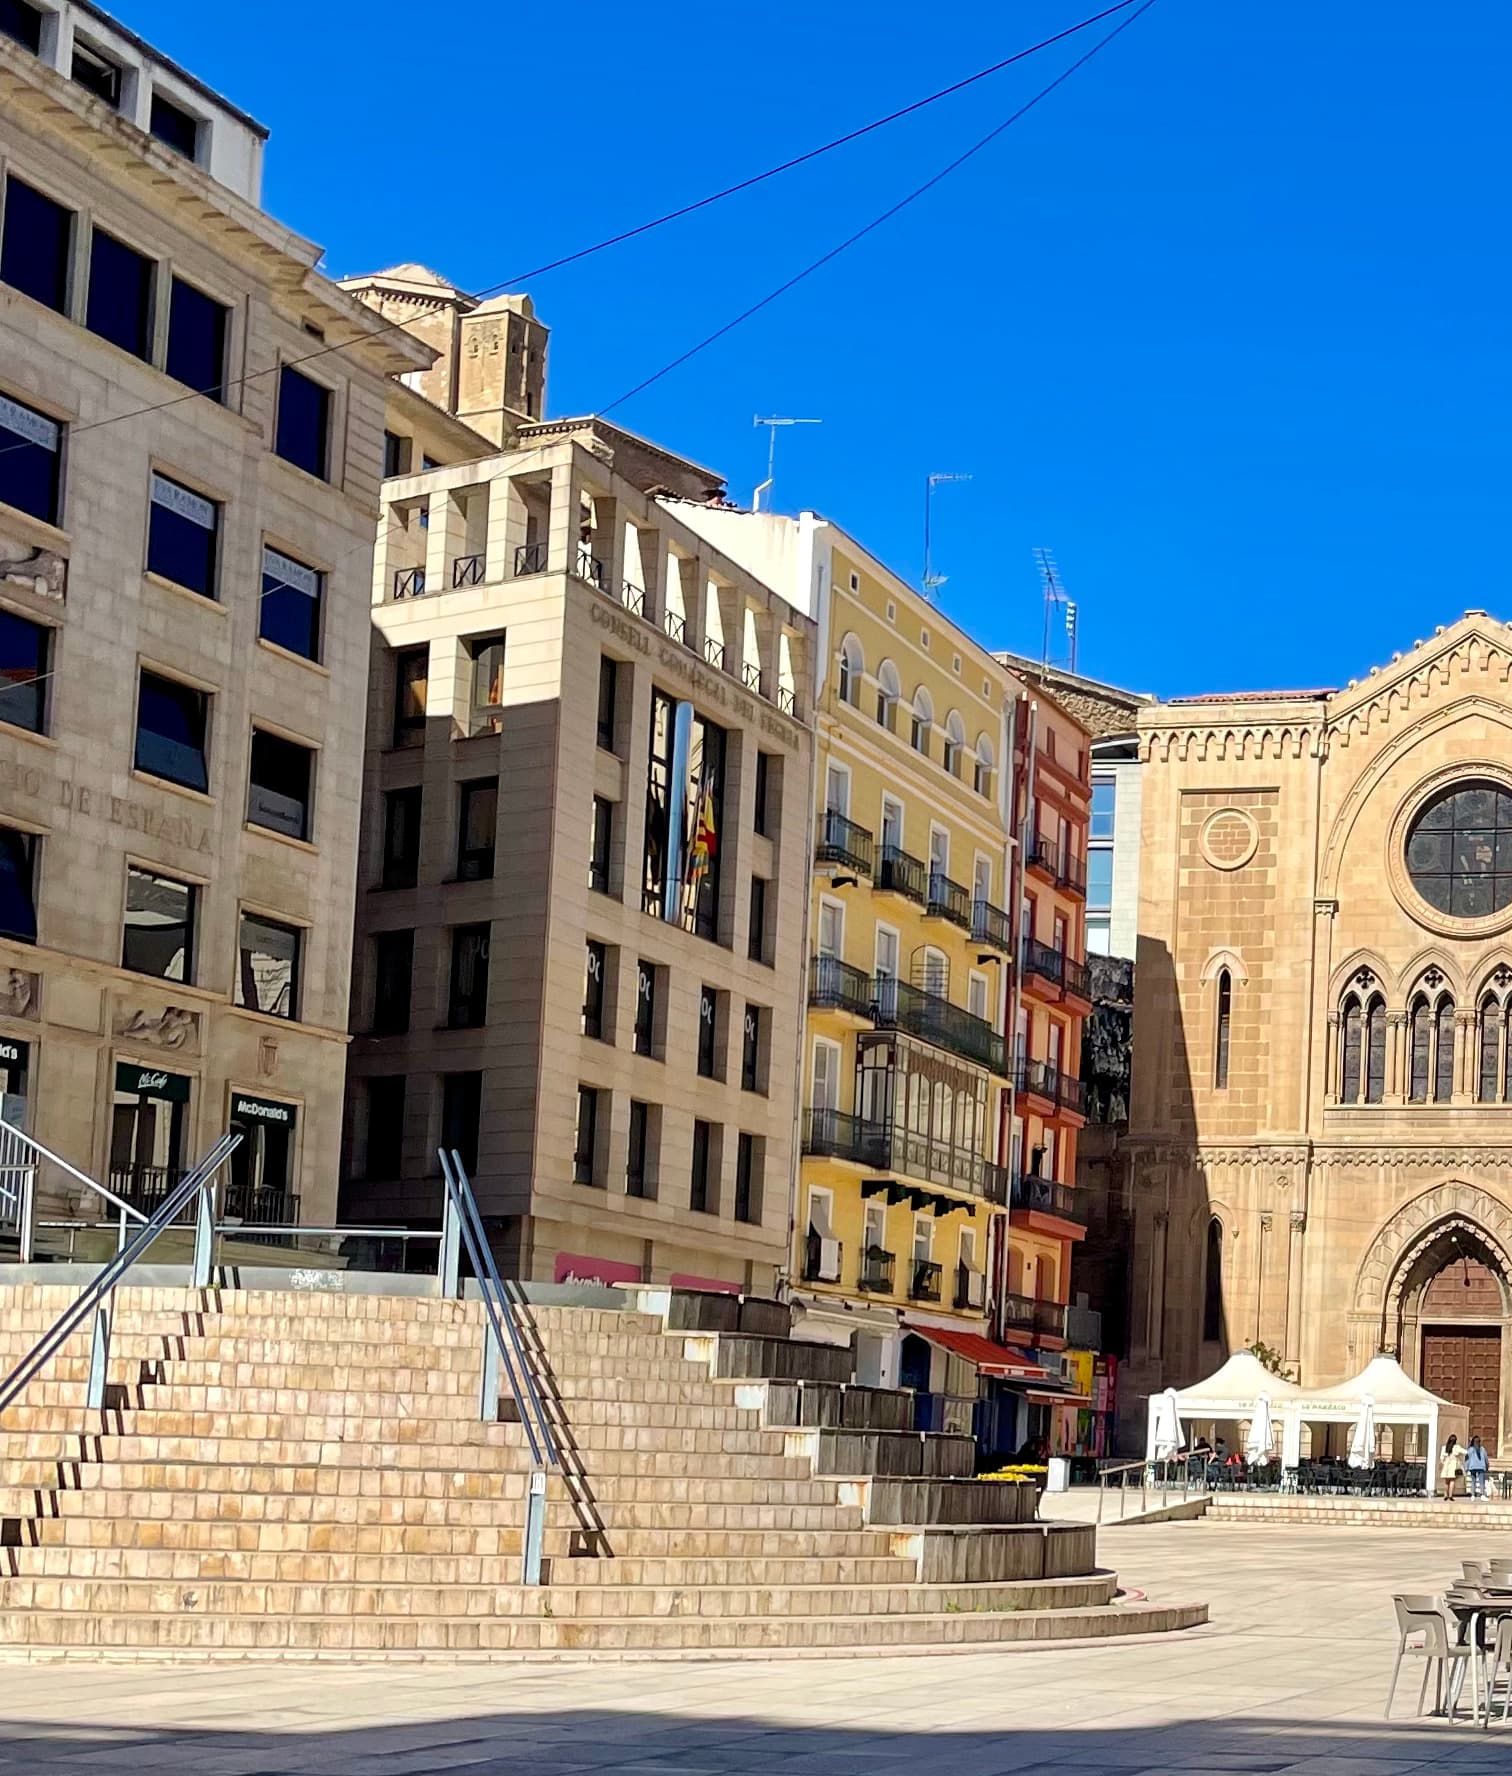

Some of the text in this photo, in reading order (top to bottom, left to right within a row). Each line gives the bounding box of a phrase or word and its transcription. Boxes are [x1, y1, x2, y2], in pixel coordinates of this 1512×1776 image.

[590, 602, 651, 657] CONSELL
[60, 779, 91, 816] DE
[110, 795, 214, 856] ESPAÑA
[237, 1099, 289, 1122] McDonald's
